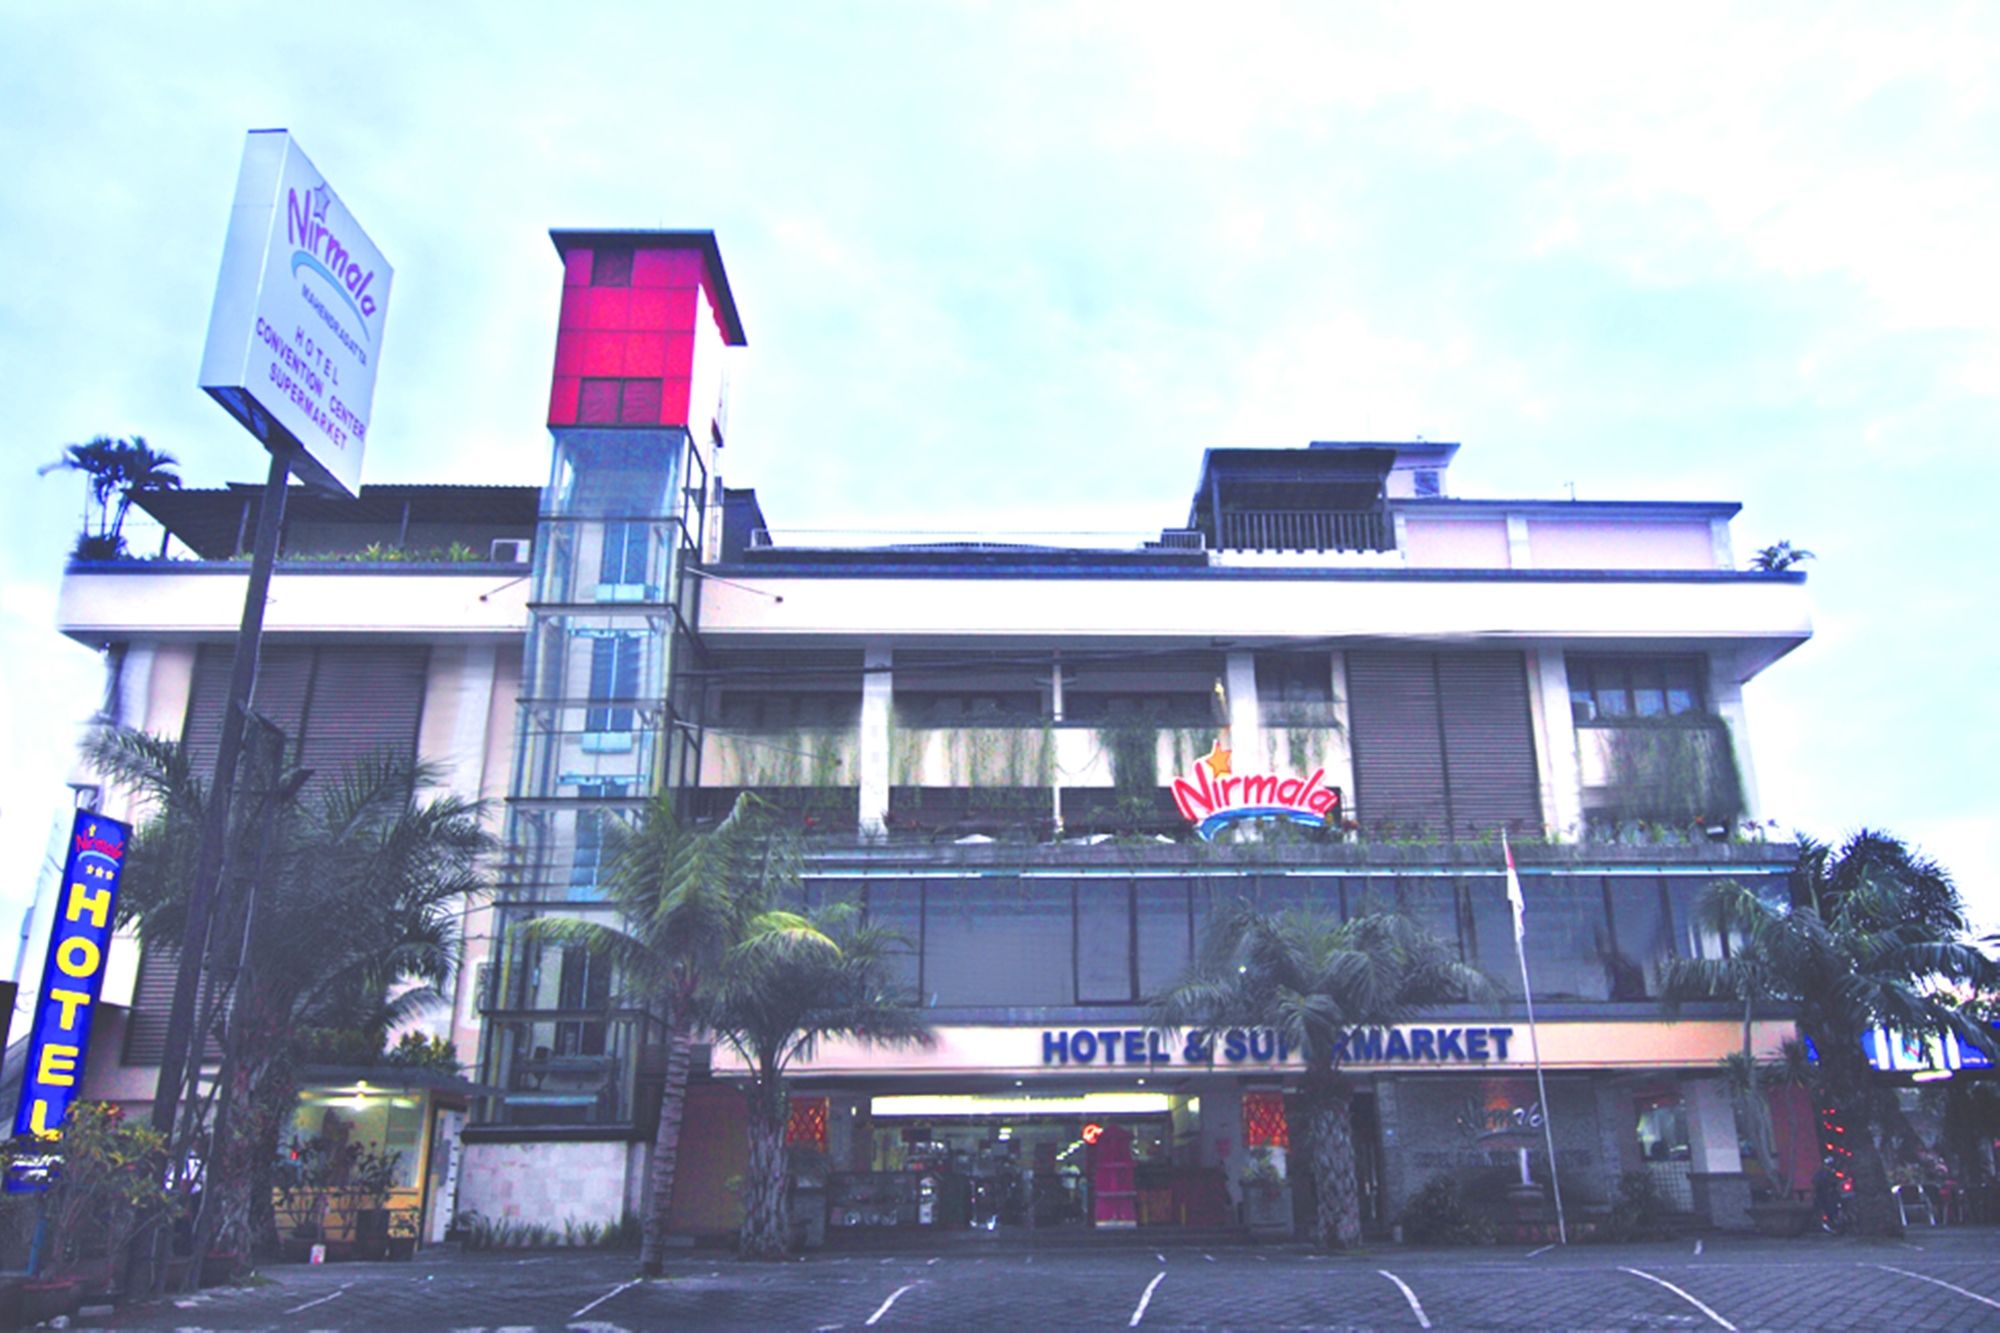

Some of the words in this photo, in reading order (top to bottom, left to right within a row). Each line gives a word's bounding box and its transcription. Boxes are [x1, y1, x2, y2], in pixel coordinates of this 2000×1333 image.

[287, 187, 376, 317] Nirmala
[256, 316, 323, 399] CONVENTION
[330, 395, 366, 441] CENTER
[295, 325, 338, 387] HOTEL
[269, 362, 347, 450] SUPERMARKET
[1172, 761, 1339, 824] Nirmala
[29, 883, 111, 1142] HOTEL
[1042, 1030, 1171, 1064] HOTEL
[1183, 1030, 1208, 1063] &
[1224, 1027, 1514, 1064] SURMARKET
